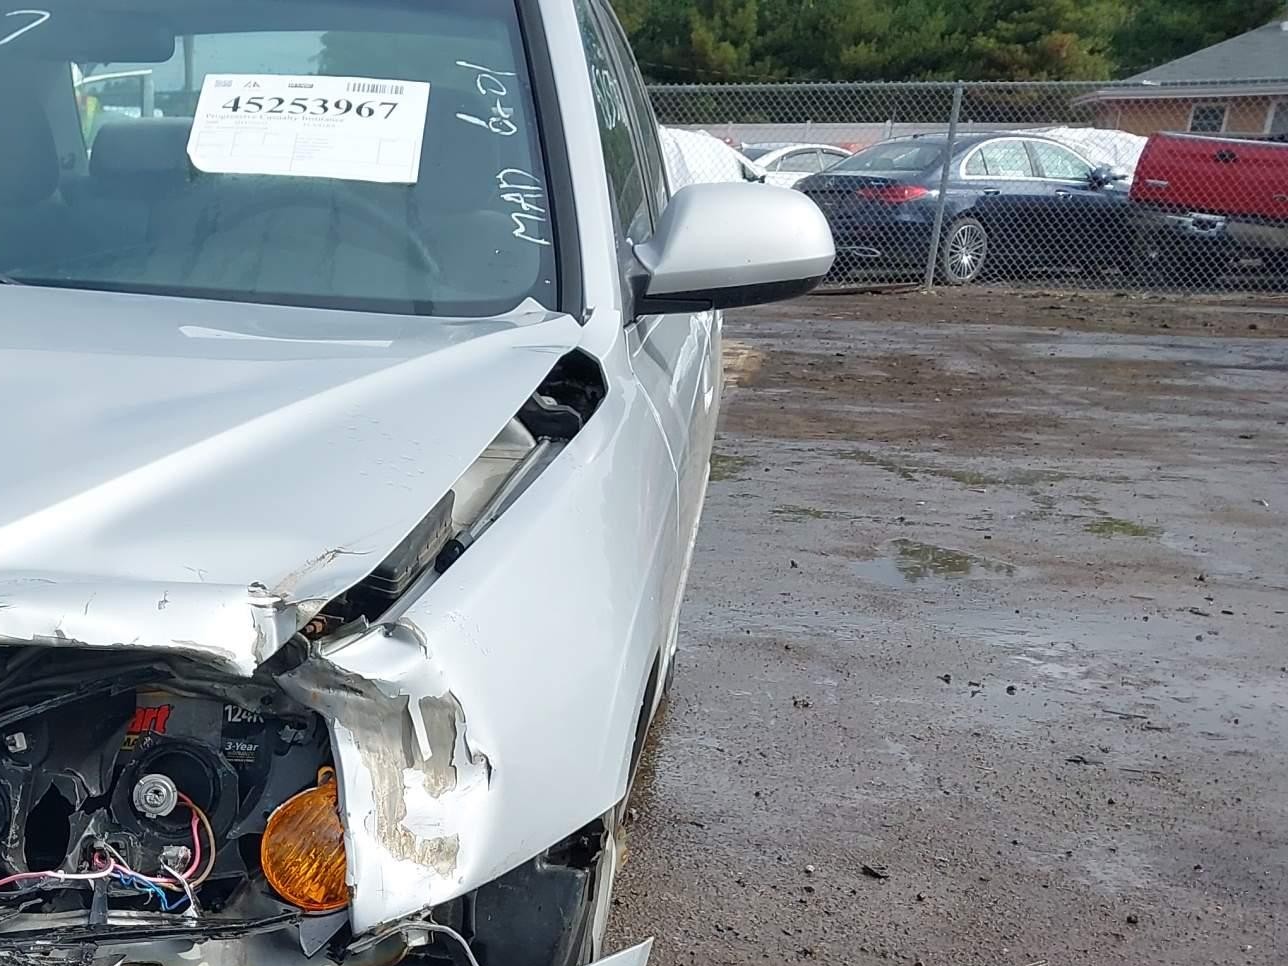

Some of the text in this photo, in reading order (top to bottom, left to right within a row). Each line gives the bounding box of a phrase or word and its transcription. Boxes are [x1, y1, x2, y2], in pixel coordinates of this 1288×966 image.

[222, 95, 399, 120] 45253967
[127, 704, 172, 734] art
[224, 741, 260, 751] 3-Year
